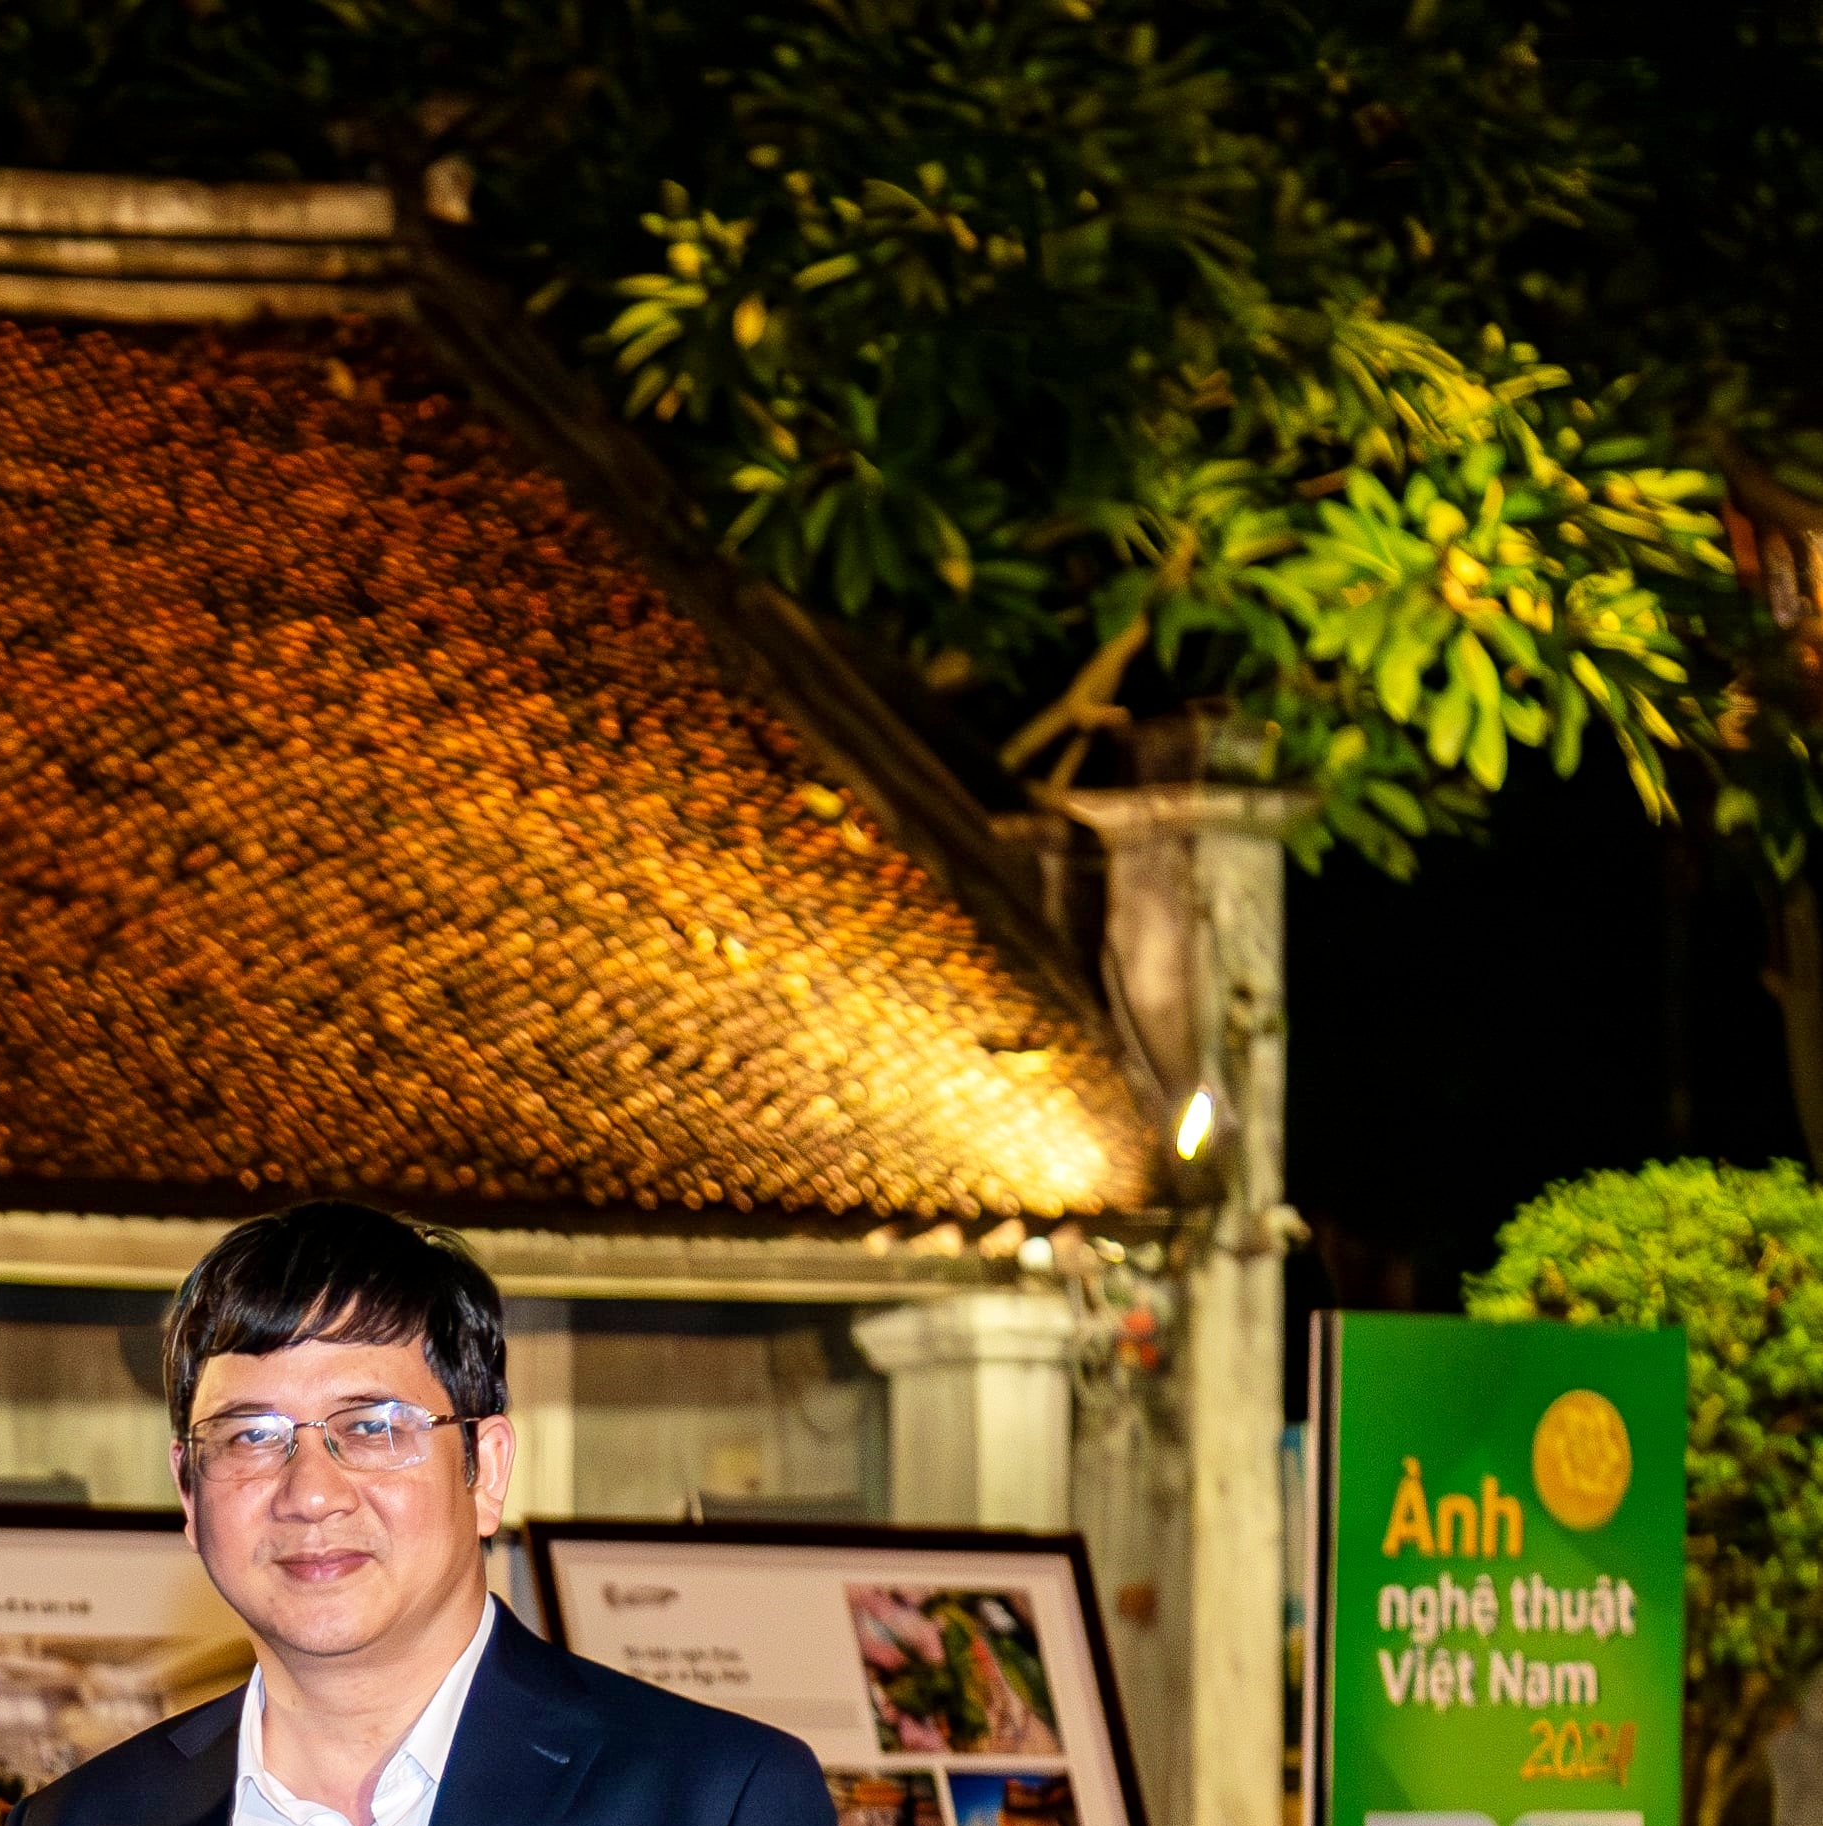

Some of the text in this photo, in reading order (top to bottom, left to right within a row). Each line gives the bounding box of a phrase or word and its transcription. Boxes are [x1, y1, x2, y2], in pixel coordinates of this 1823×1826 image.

[1381, 1455, 1525, 1559] Ảnh
[1378, 1571, 1637, 1644] nghệ thuật
[1377, 1645, 1598, 1713] Việt Nam
